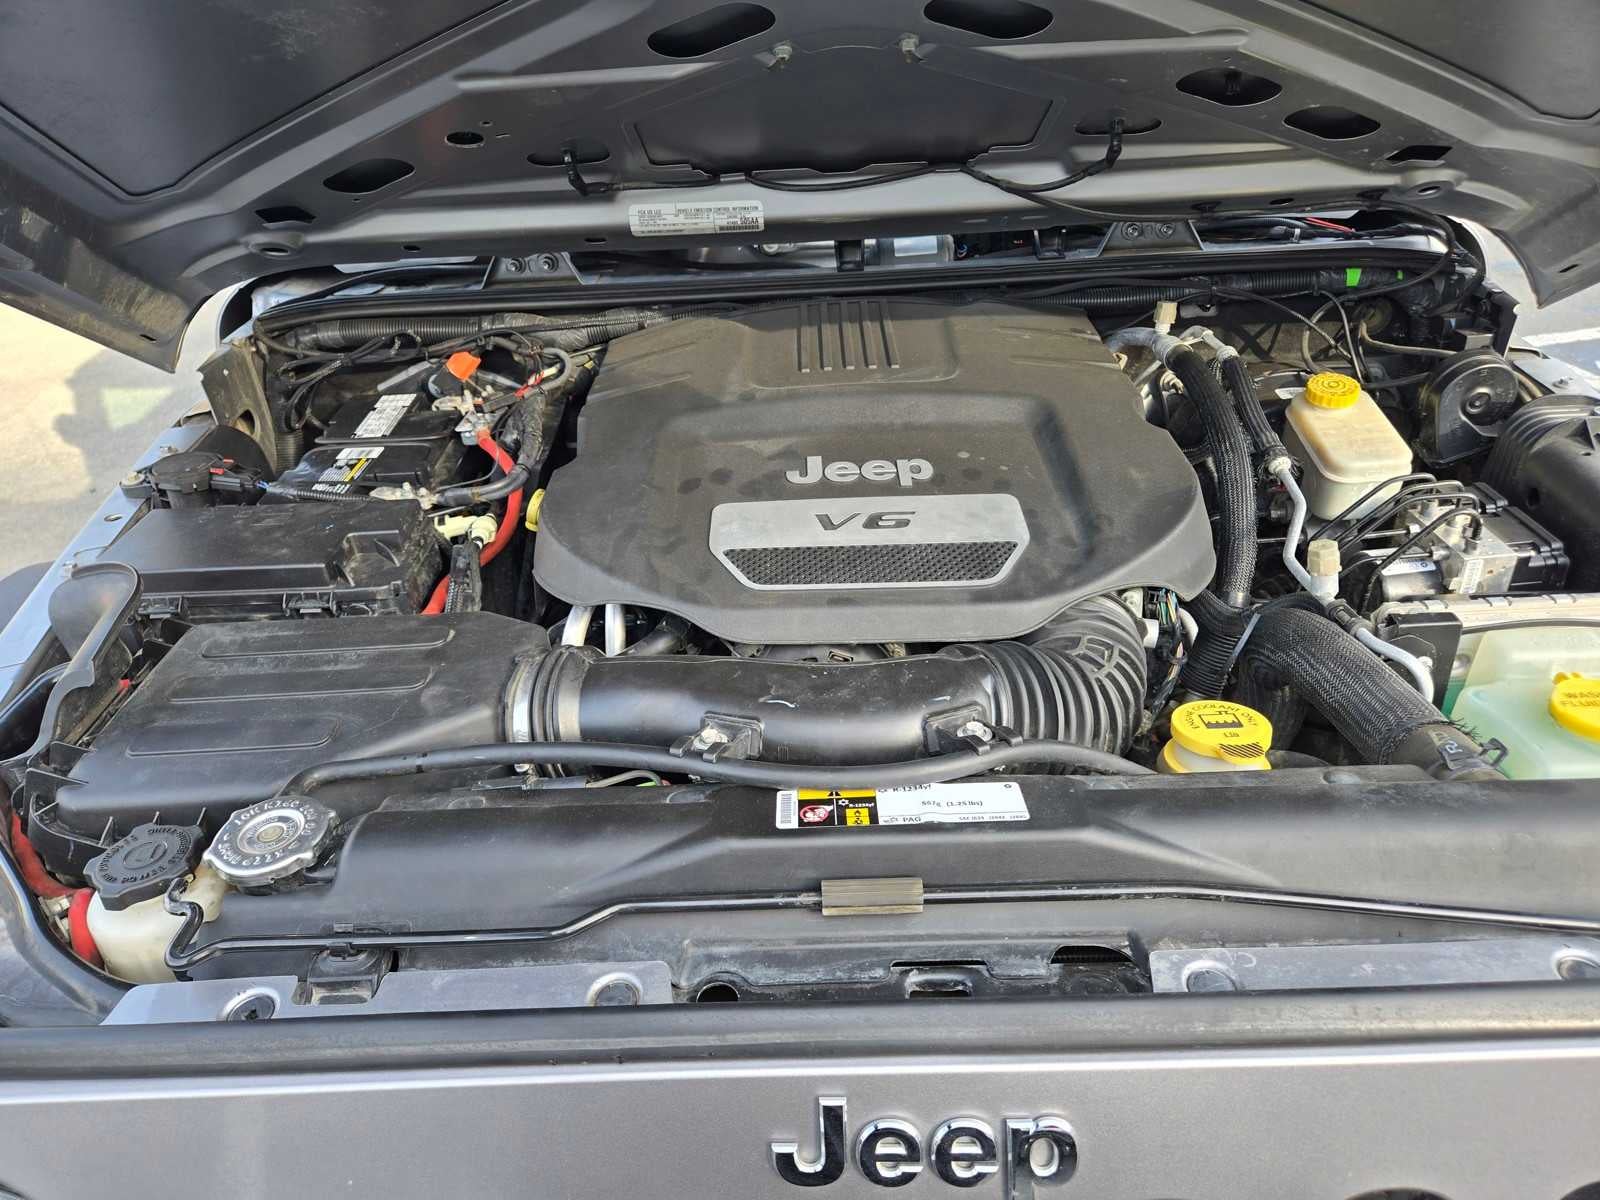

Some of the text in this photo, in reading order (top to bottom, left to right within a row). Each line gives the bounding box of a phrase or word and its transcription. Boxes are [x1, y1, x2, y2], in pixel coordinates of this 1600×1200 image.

[786, 456, 934, 486] Jeep
[815, 511, 916, 531] V6
[1192, 703, 1240, 712] COOLANT
[1241, 712, 1257, 727] ONLY
[771, 1096, 1077, 1200] Jeep
